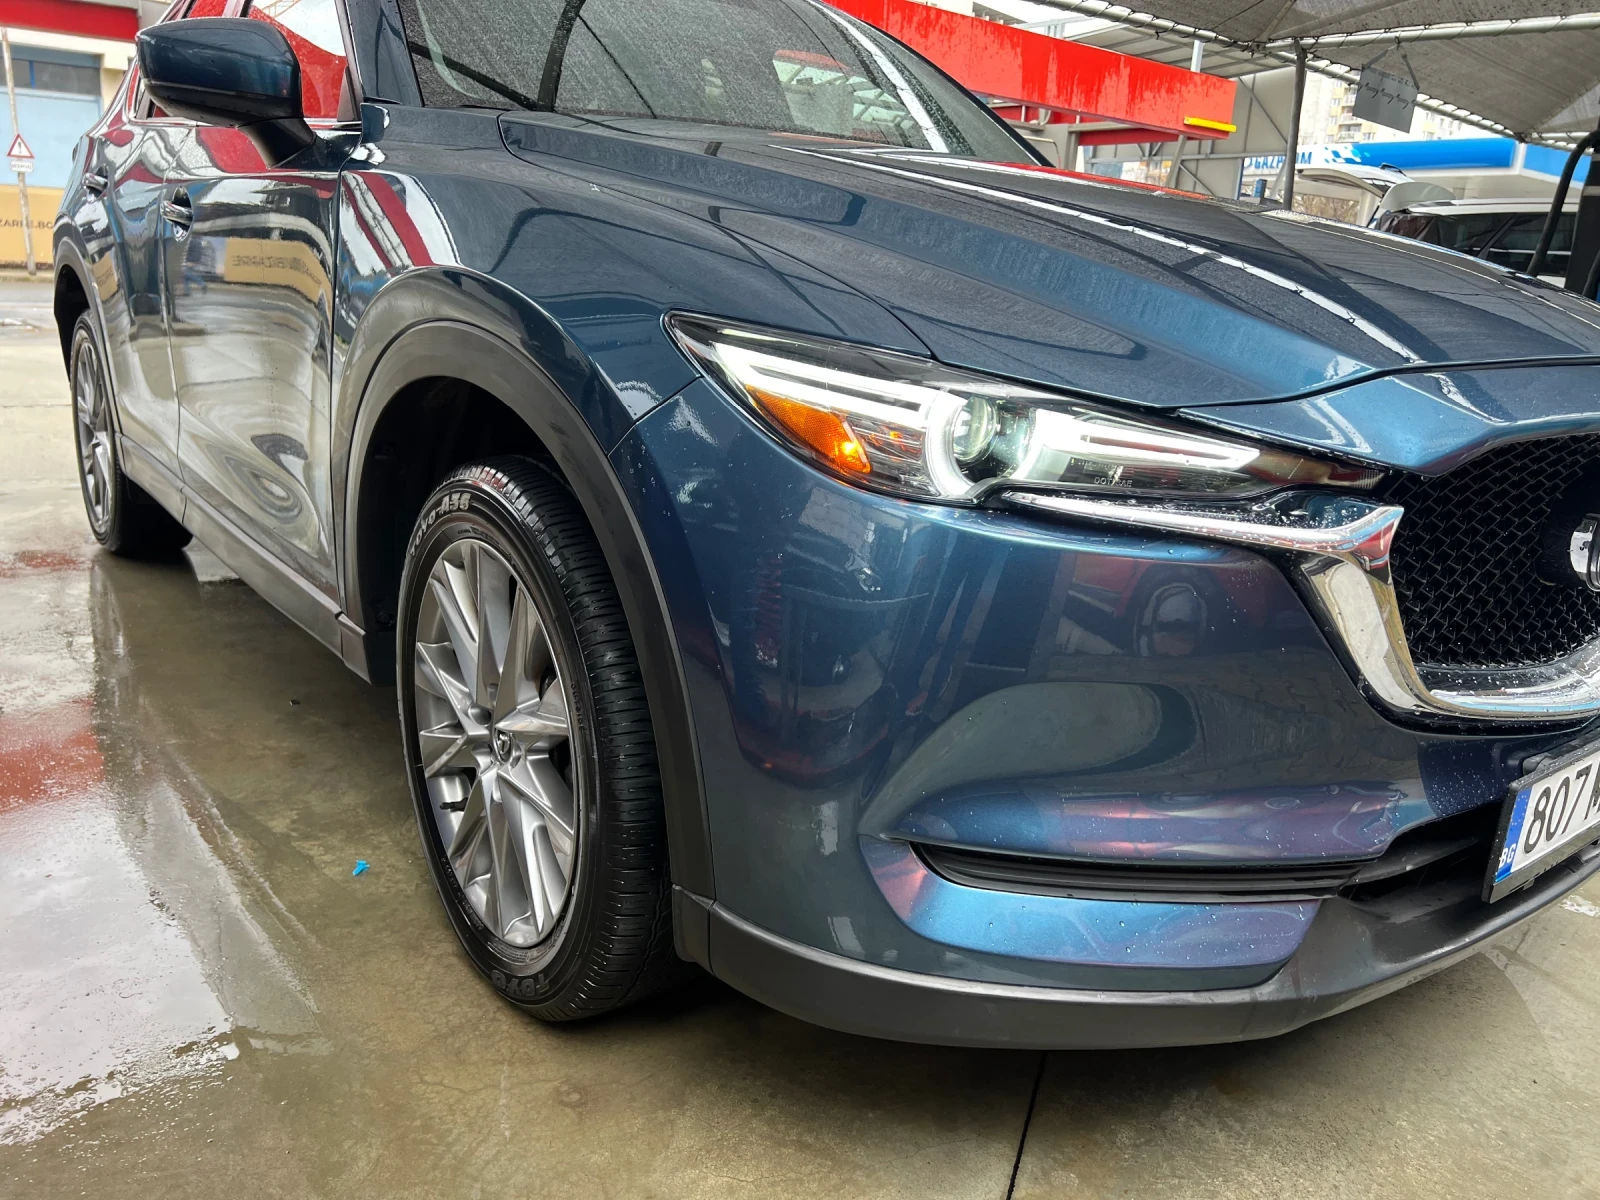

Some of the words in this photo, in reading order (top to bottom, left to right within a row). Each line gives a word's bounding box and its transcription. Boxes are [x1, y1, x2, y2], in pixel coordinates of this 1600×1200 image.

[1254, 152, 1312, 169] GAZPM
[0, 219, 54, 229] ZAR.BG
[1499, 843, 1516, 868] BG
[491, 969, 550, 996] TOYO
